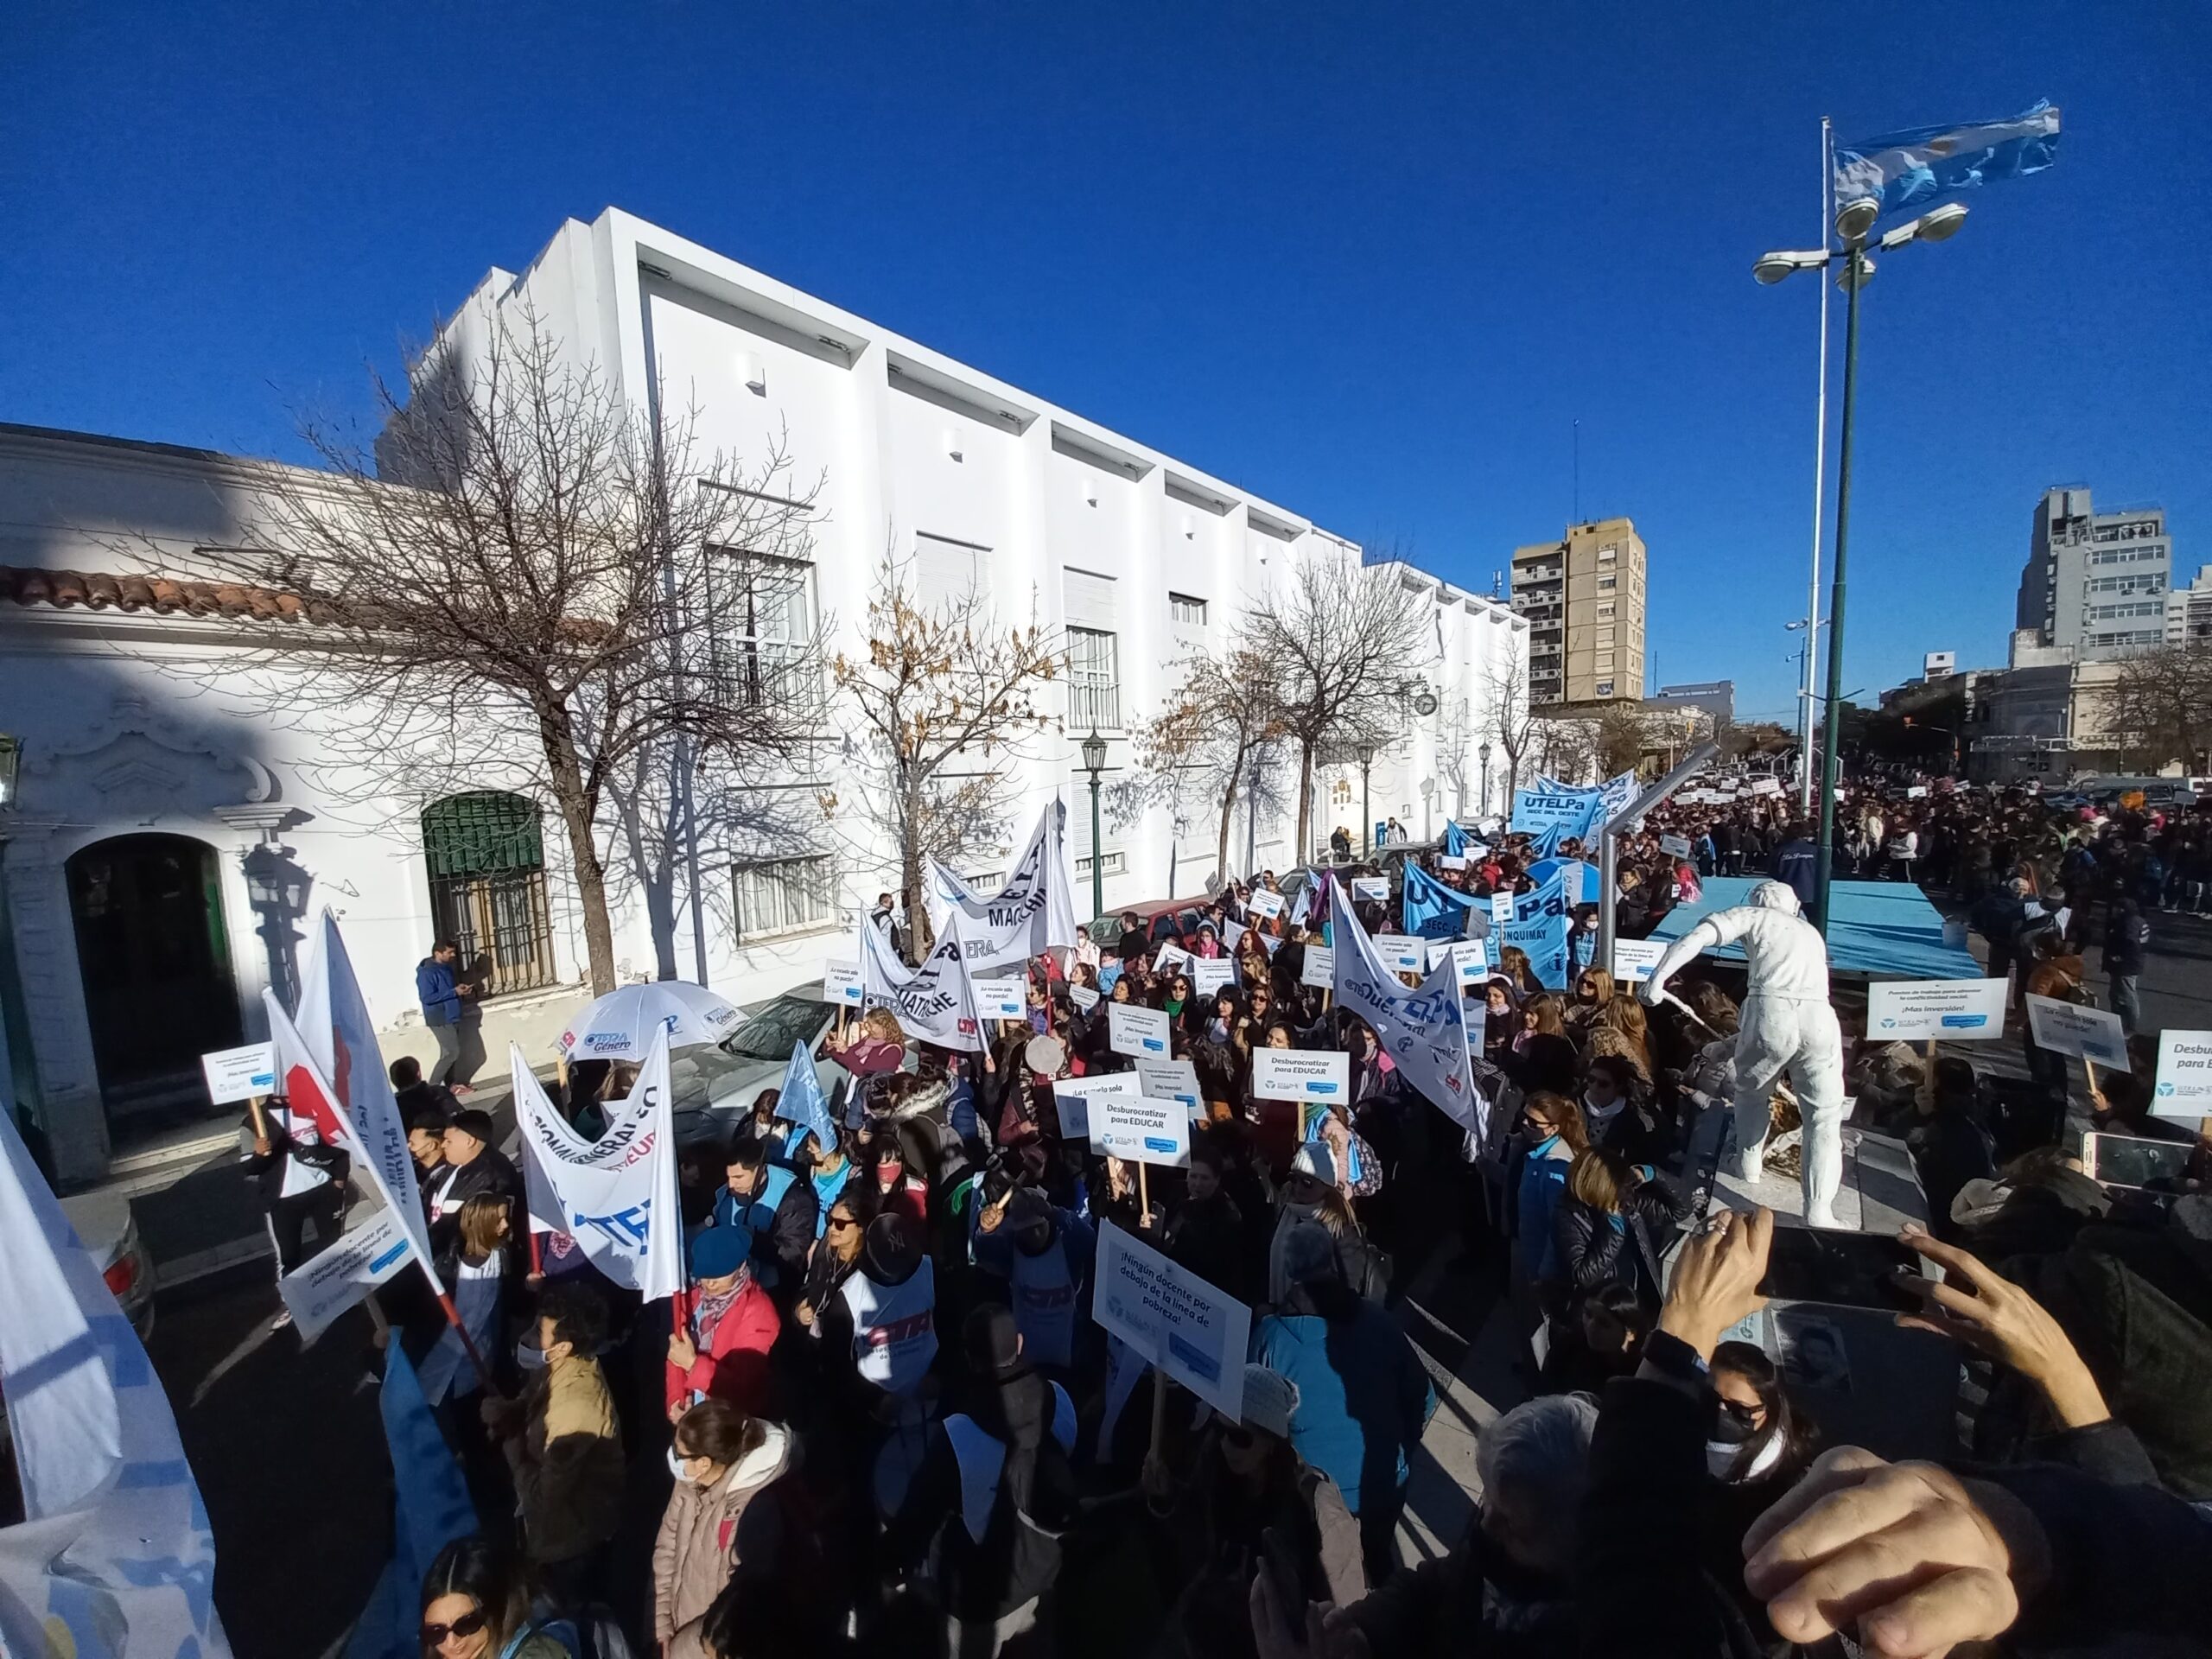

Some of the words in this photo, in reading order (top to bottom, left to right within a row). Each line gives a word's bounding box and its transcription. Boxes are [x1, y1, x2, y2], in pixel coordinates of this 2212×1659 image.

[1524, 797, 1585, 810] UTELPa
[594, 1040, 631, 1051] Género
[1271, 1057, 1330, 1067] Desburocratizar
[2177, 1059, 2204, 1069] para
[1107, 1103, 1167, 1119] Desburocratizar
[1110, 1116, 1128, 1125] para
[1129, 1119, 1164, 1128] EDUCAR
[343, 1230, 376, 1256] docente
[376, 1222, 389, 1235] por
[341, 1257, 353, 1268] de
[353, 1249, 362, 1259] la
[362, 1239, 382, 1254] línea
[382, 1229, 392, 1239] de
[1121, 1251, 1154, 1279] ¡Ningún
[1155, 1274, 1192, 1302] docente
[1193, 1297, 1211, 1313] por
[1120, 1266, 1148, 1290] debajo
[1149, 1284, 1161, 1298] de
[1162, 1292, 1171, 1303] la
[1172, 1296, 1195, 1319] línea
[1197, 1313, 1210, 1328] de
[1142, 1294, 1181, 1325] pobreza!
